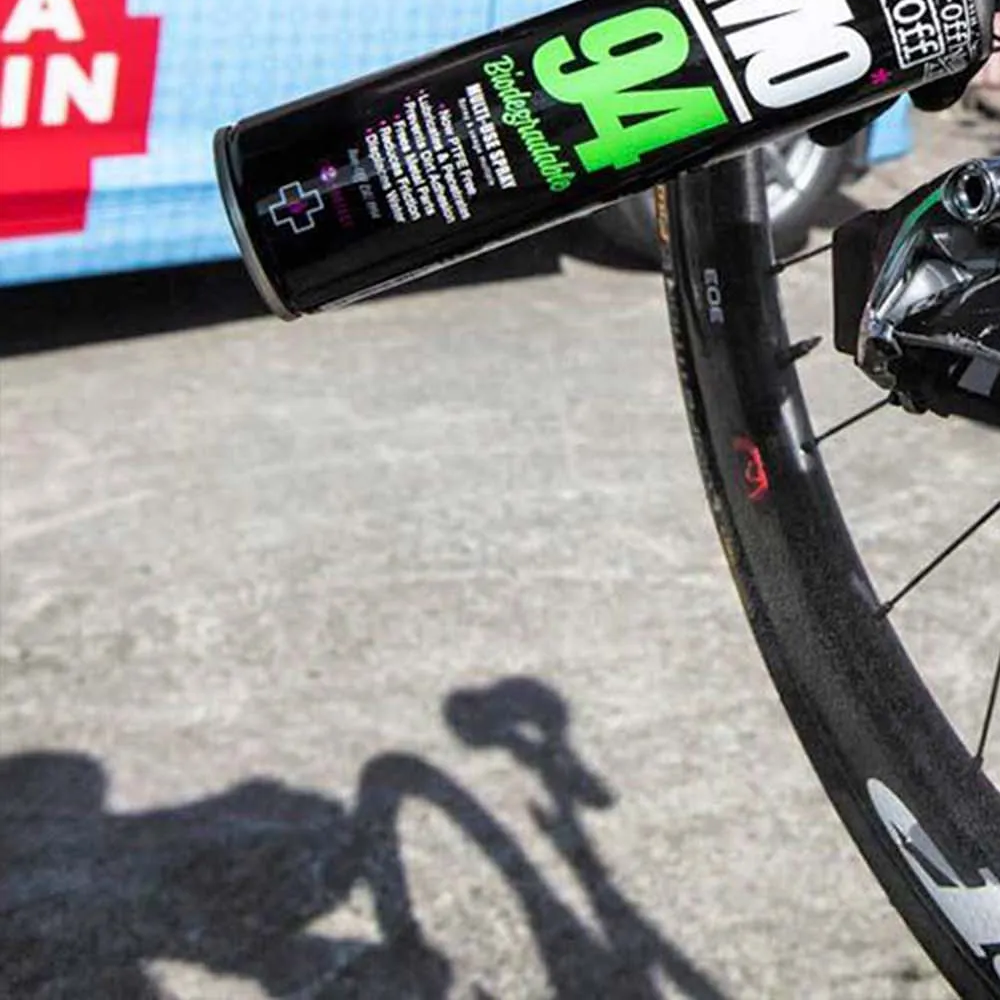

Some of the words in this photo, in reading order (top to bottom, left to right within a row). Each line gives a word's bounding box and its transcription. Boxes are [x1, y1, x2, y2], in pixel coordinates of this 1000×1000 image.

[532, 6, 730, 174] 94
[402, 100, 430, 150] Prevents
[437, 107, 458, 137] Now
[465, 81, 502, 150] MULTI-USE
[488, 147, 516, 191] SPRAY
[484, 55, 576, 191] Biodegradable
[362, 132, 394, 191] Displaces
[384, 189, 406, 224] Water
[377, 125, 406, 177] Reduces
[395, 176, 421, 221] Friction
[416, 93, 446, 151] Lubricates
[440, 162, 471, 221] Penetrates
[419, 148, 437, 173] Dirt
[447, 135, 469, 170] PTFE
[416, 184, 437, 216] Parts
[427, 171, 456, 225] Adhesion
[458, 168, 479, 197] Free
